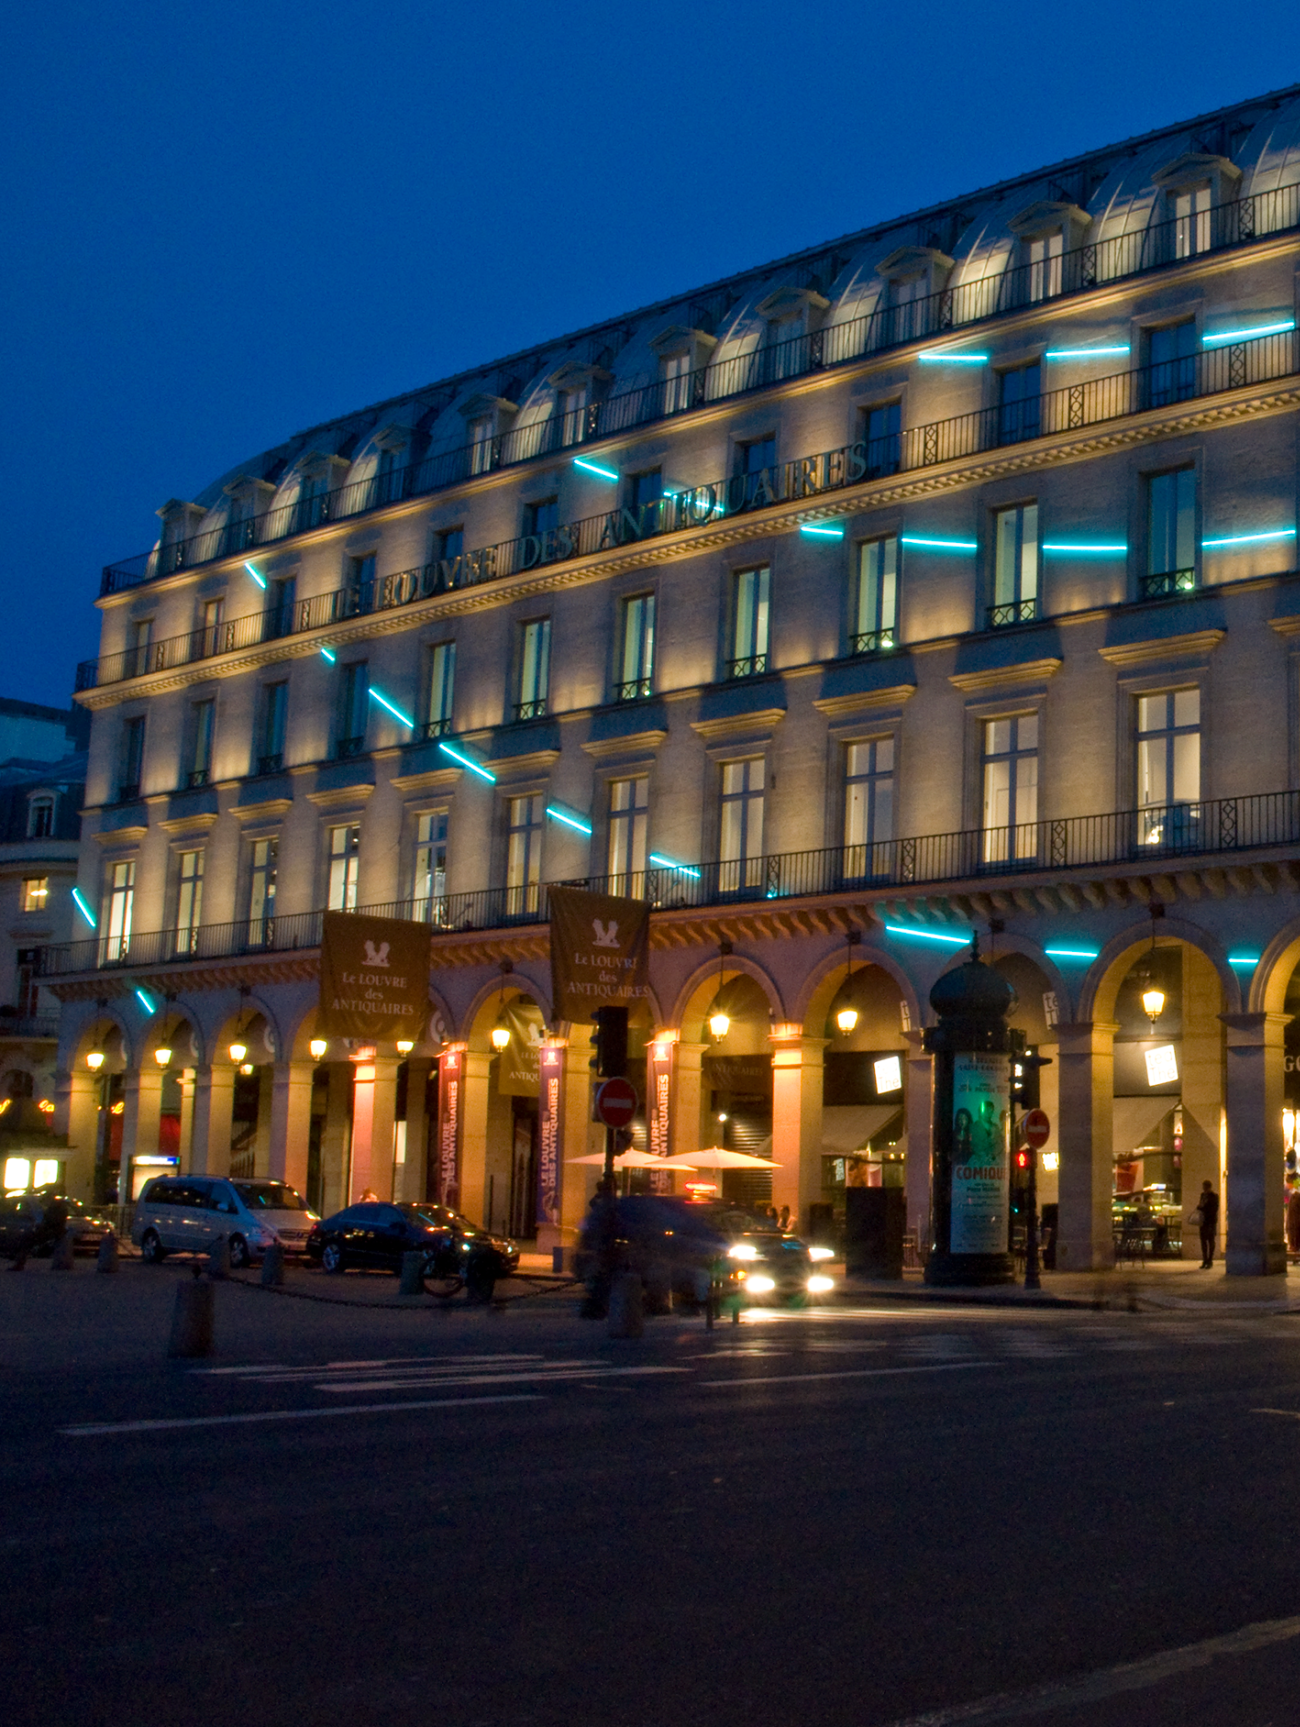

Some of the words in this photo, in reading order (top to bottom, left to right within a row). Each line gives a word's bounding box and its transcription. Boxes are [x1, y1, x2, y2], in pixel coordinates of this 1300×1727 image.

[375, 547, 498, 609] LOUVRE
[520, 529, 575, 570] DES
[600, 440, 867, 548] ANTIQUAIRES
[574, 953, 588, 965] Le
[342, 972, 356, 984] Le
[360, 973, 408, 989] LOUVRE
[598, 970, 618, 982] des
[364, 988, 384, 1000] des
[567, 981, 649, 998] ANTIQUAIRES
[331, 999, 414, 1015] ANTIQUAIRES
[448, 1081, 458, 1159] ANTIQUAIRES
[549, 1078, 559, 1160] ANTIQUAIRES
[658, 1074, 669, 1158] ANTIQUAIRES
[442, 1122, 450, 1169] LOUVRE
[541, 1121, 550, 1169] LOUVRE
[541, 1172, 549, 1187] LE
[548, 1163, 556, 1187] DES
